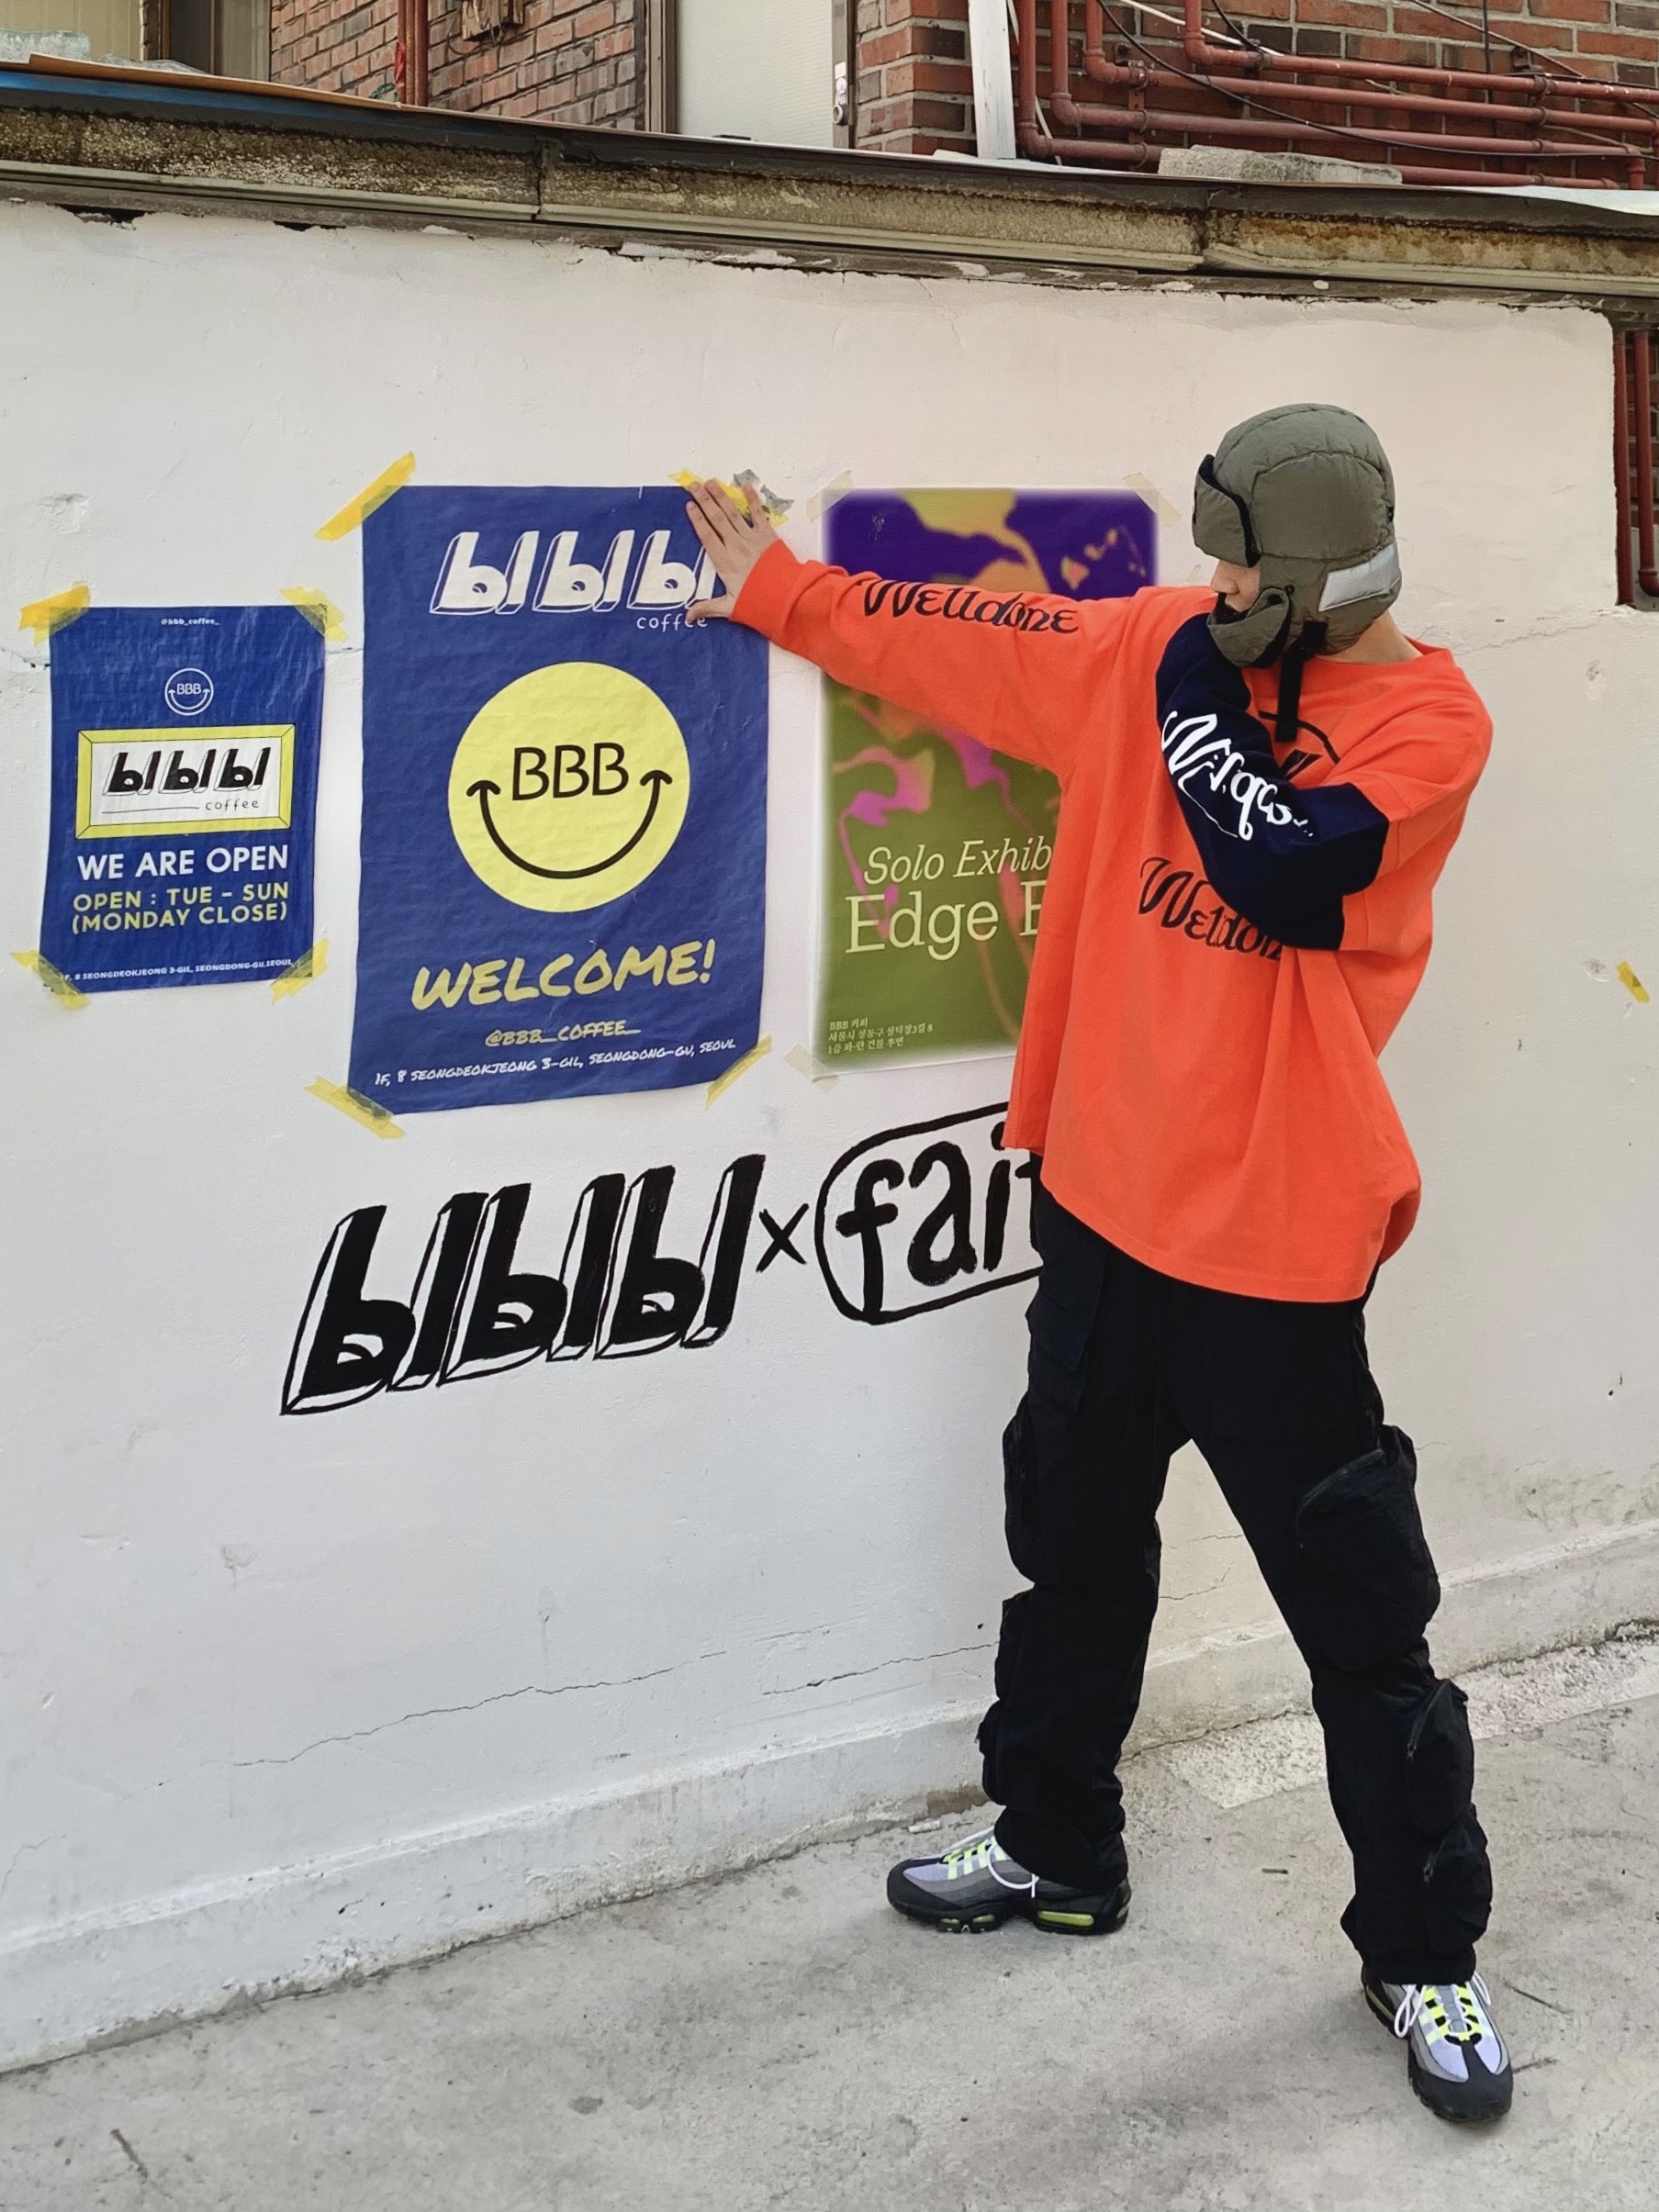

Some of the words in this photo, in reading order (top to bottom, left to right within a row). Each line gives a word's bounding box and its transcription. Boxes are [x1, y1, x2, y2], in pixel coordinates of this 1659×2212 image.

[176, 683, 202, 695] BBB
[511, 742, 629, 801] BBB
[205, 799, 260, 811] coffee
[77, 854, 124, 881] WE
[135, 849, 195, 877] ARE
[206, 844, 288, 873] OPEN
[864, 843, 945, 885] Solo
[73, 890, 141, 912] OPEN
[166, 886, 213, 906] TUE
[242, 882, 288, 901] SUN
[72, 908, 190, 934] (MONDAY
[198, 901, 287, 924] CLOSE)
[845, 890, 1000, 961] Edge
[410, 938, 716, 1011] WELCOME!
[485, 1020, 642, 1047] @BBB_COFFEE_
[397, 1069, 407, 1083] 8
[410, 1060, 538, 1082] SEONGDEOKJEONG
[542, 1056, 584, 1070] 3-GIL,
[588, 1045, 695, 1066] SEONGDONG-GU,
[700, 1039, 736, 1054] SEOUL
[834, 1119, 1032, 1323] fai
